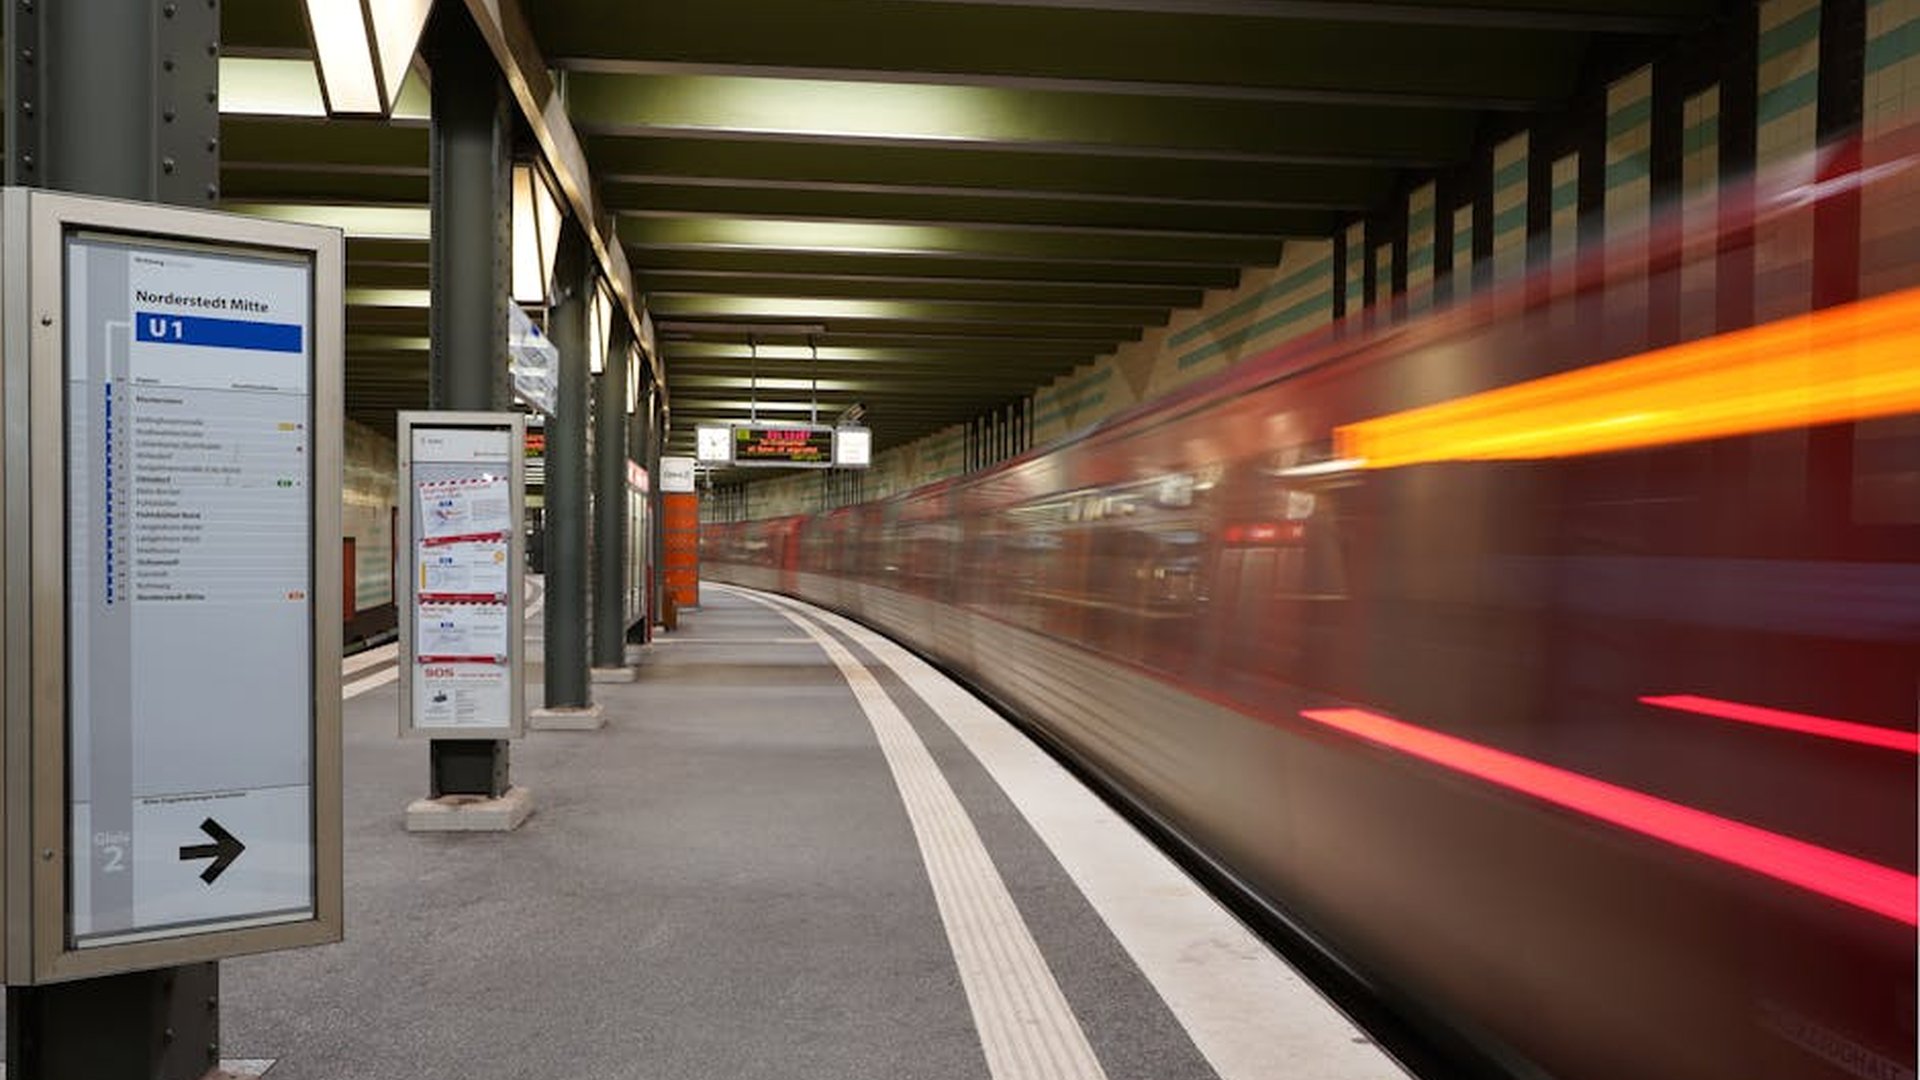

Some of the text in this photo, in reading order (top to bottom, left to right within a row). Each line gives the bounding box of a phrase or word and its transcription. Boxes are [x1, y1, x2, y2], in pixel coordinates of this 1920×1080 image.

[136, 290, 269, 314] Norderstedt Mitte
[424, 668, 455, 678] SOS
[94, 830, 131, 847] Gleis
[103, 847, 125, 873] 2
